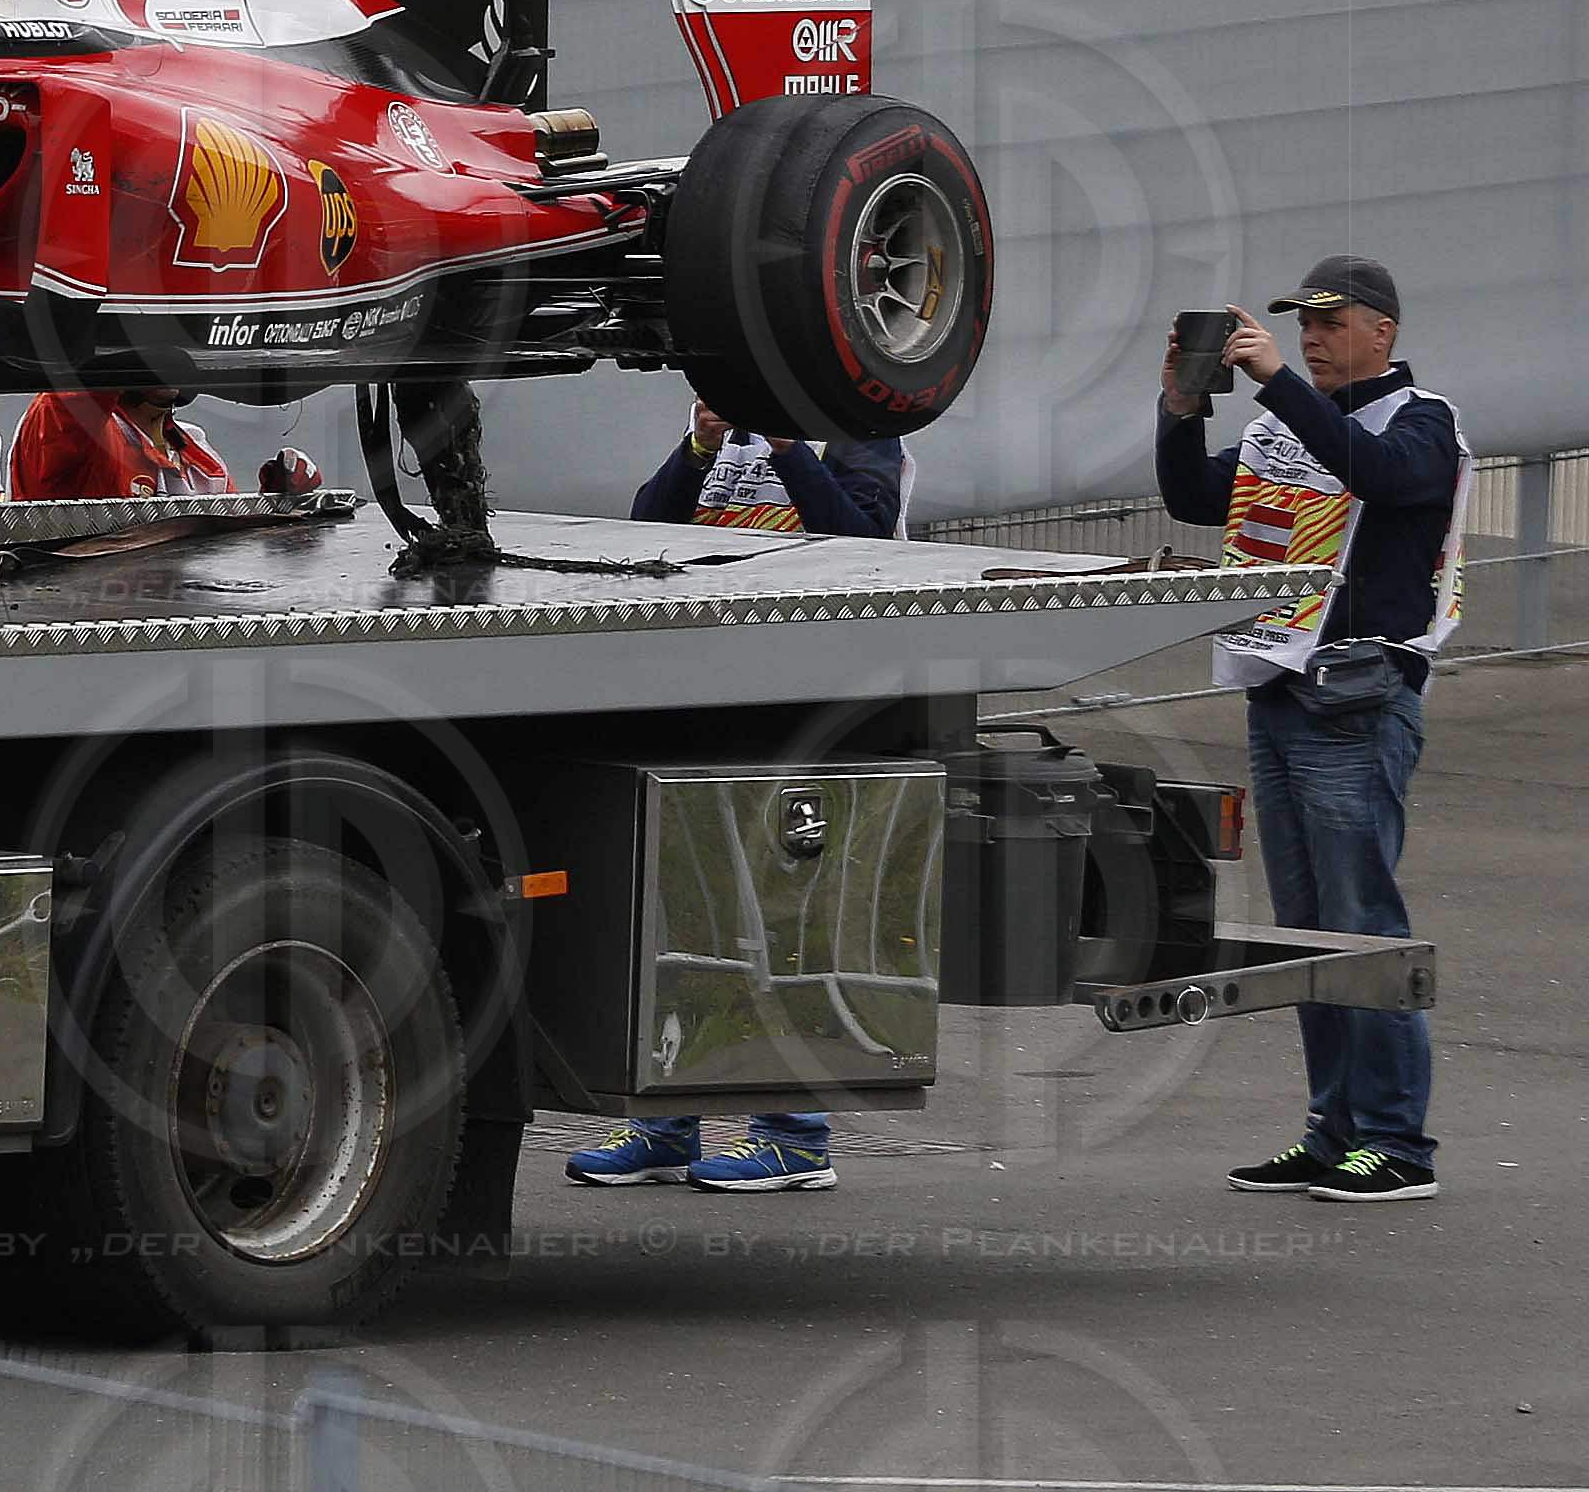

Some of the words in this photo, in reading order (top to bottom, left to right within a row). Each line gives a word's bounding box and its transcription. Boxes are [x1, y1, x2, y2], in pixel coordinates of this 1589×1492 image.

[155, 9, 223, 21] SCUDERIA
[0, 21, 74, 40] HUBLOT
[188, 22, 244, 32] FERRARI
[65, 184, 101, 196] SINGHA
[322, 192, 356, 258] ups
[207, 314, 259, 346] infor
[312, 318, 342, 339] SKF
